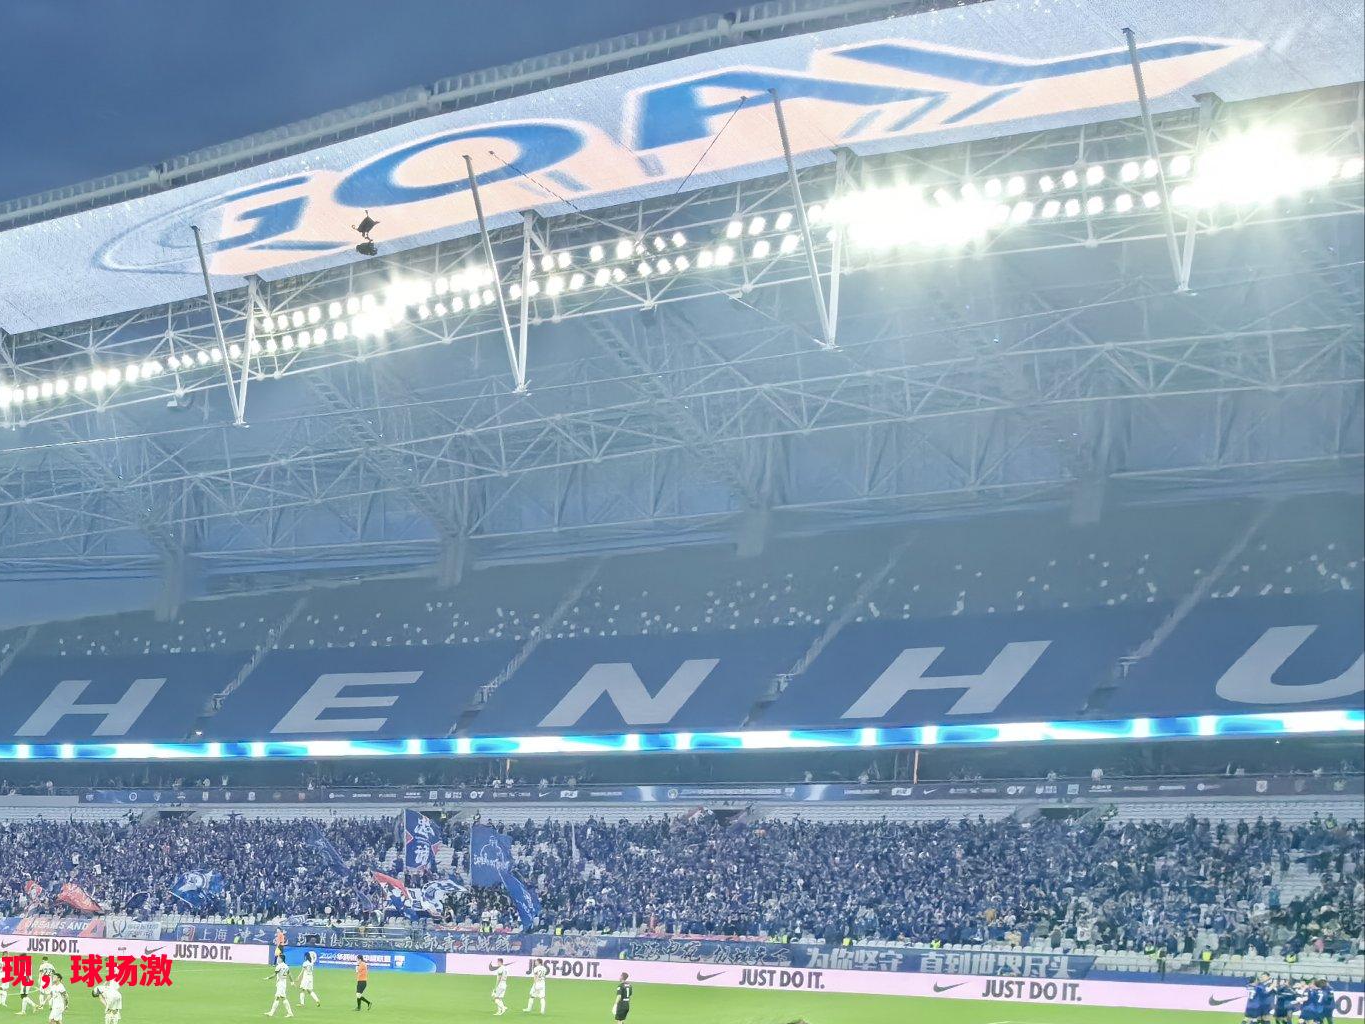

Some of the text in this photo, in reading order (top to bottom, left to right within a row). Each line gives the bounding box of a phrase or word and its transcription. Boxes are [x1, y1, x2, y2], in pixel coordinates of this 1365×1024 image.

[97, 40, 1256, 275] GOAL
[198, 927, 228, 942] 上海
[27, 938, 80, 953] JUST DO IT.
[173, 944, 232, 960] JUST DO IT.
[561, 960, 584, 977] DO
[586, 961, 602, 978] IT.
[806, 948, 903, 971] 为你坚守
[739, 968, 825, 989] JUST DO IT.
[982, 979, 1082, 1001] JUST DO IT.
